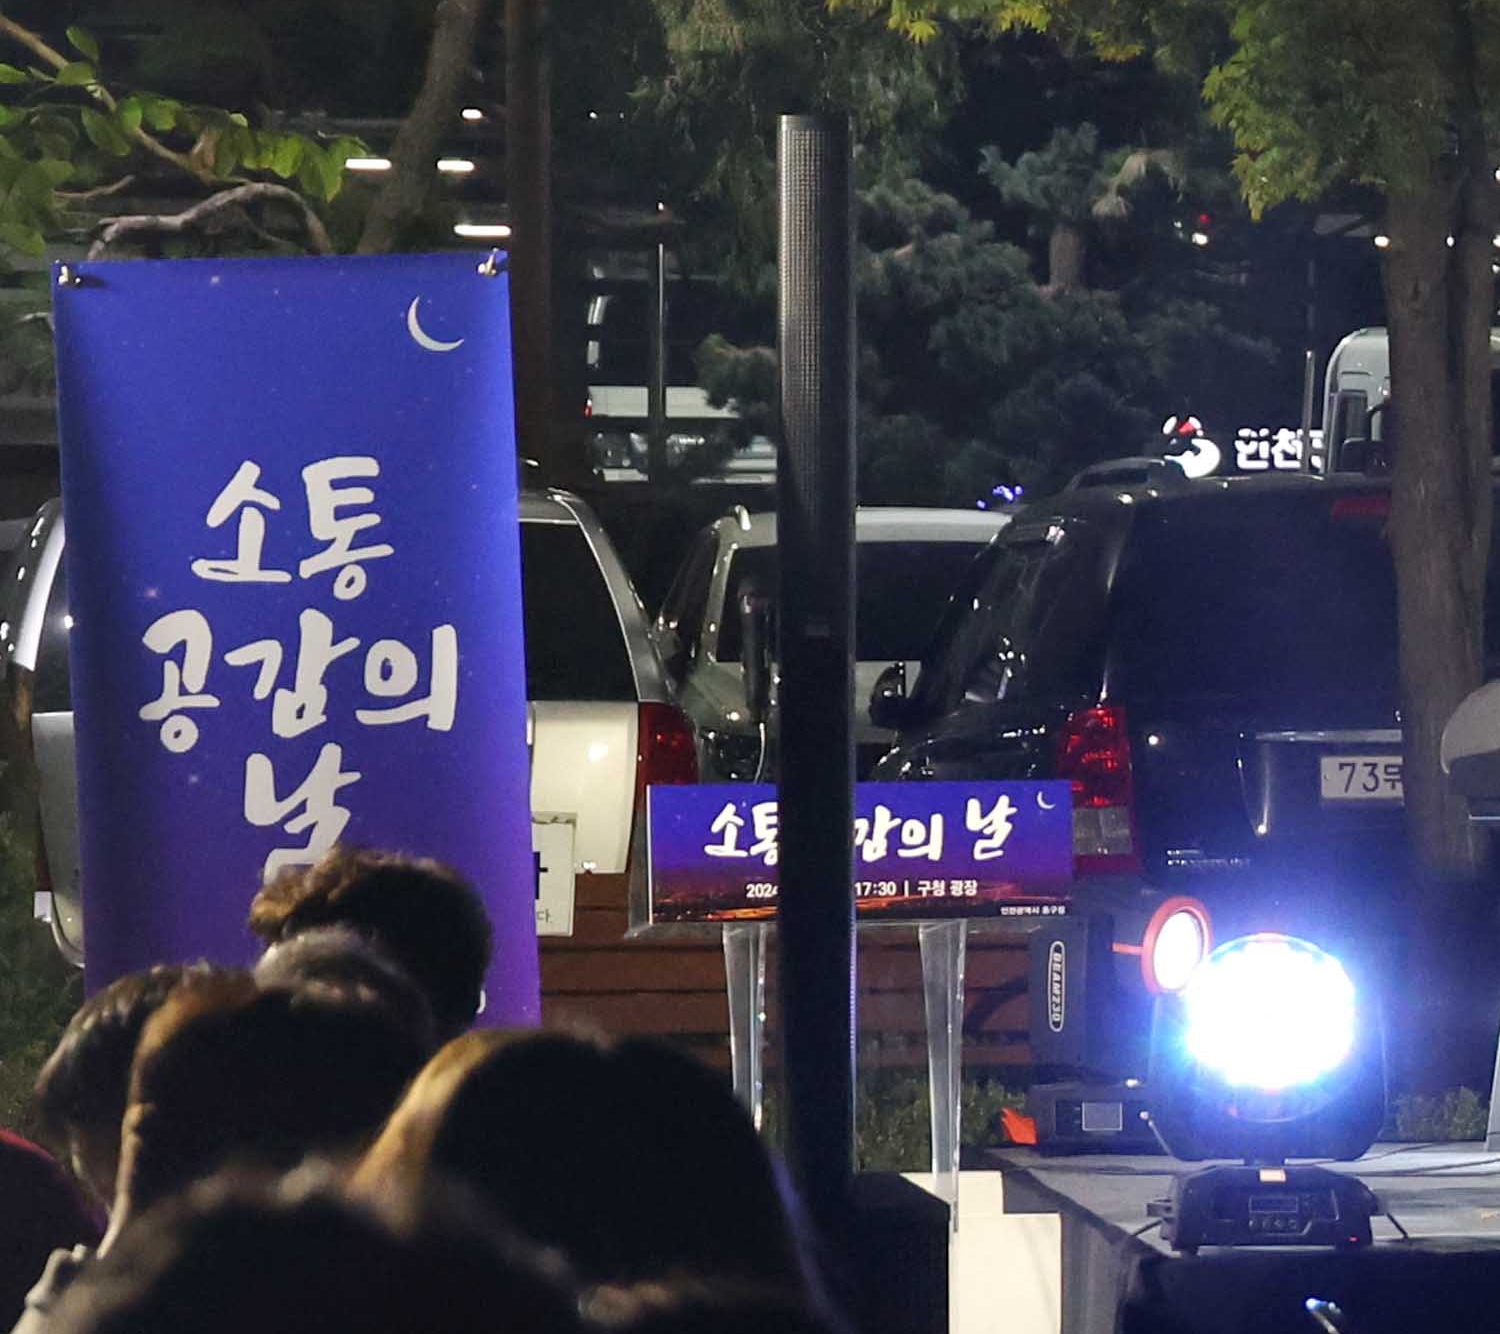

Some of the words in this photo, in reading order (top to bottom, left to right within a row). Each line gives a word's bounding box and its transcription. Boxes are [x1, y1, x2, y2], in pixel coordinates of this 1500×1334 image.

[191, 456, 394, 600] 소통
[139, 608, 458, 753] 공감의
[244, 742, 361, 887] 날
[965, 794, 1018, 861] 날
[917, 880, 945, 897] 구청
[949, 879, 978, 897] 광장
